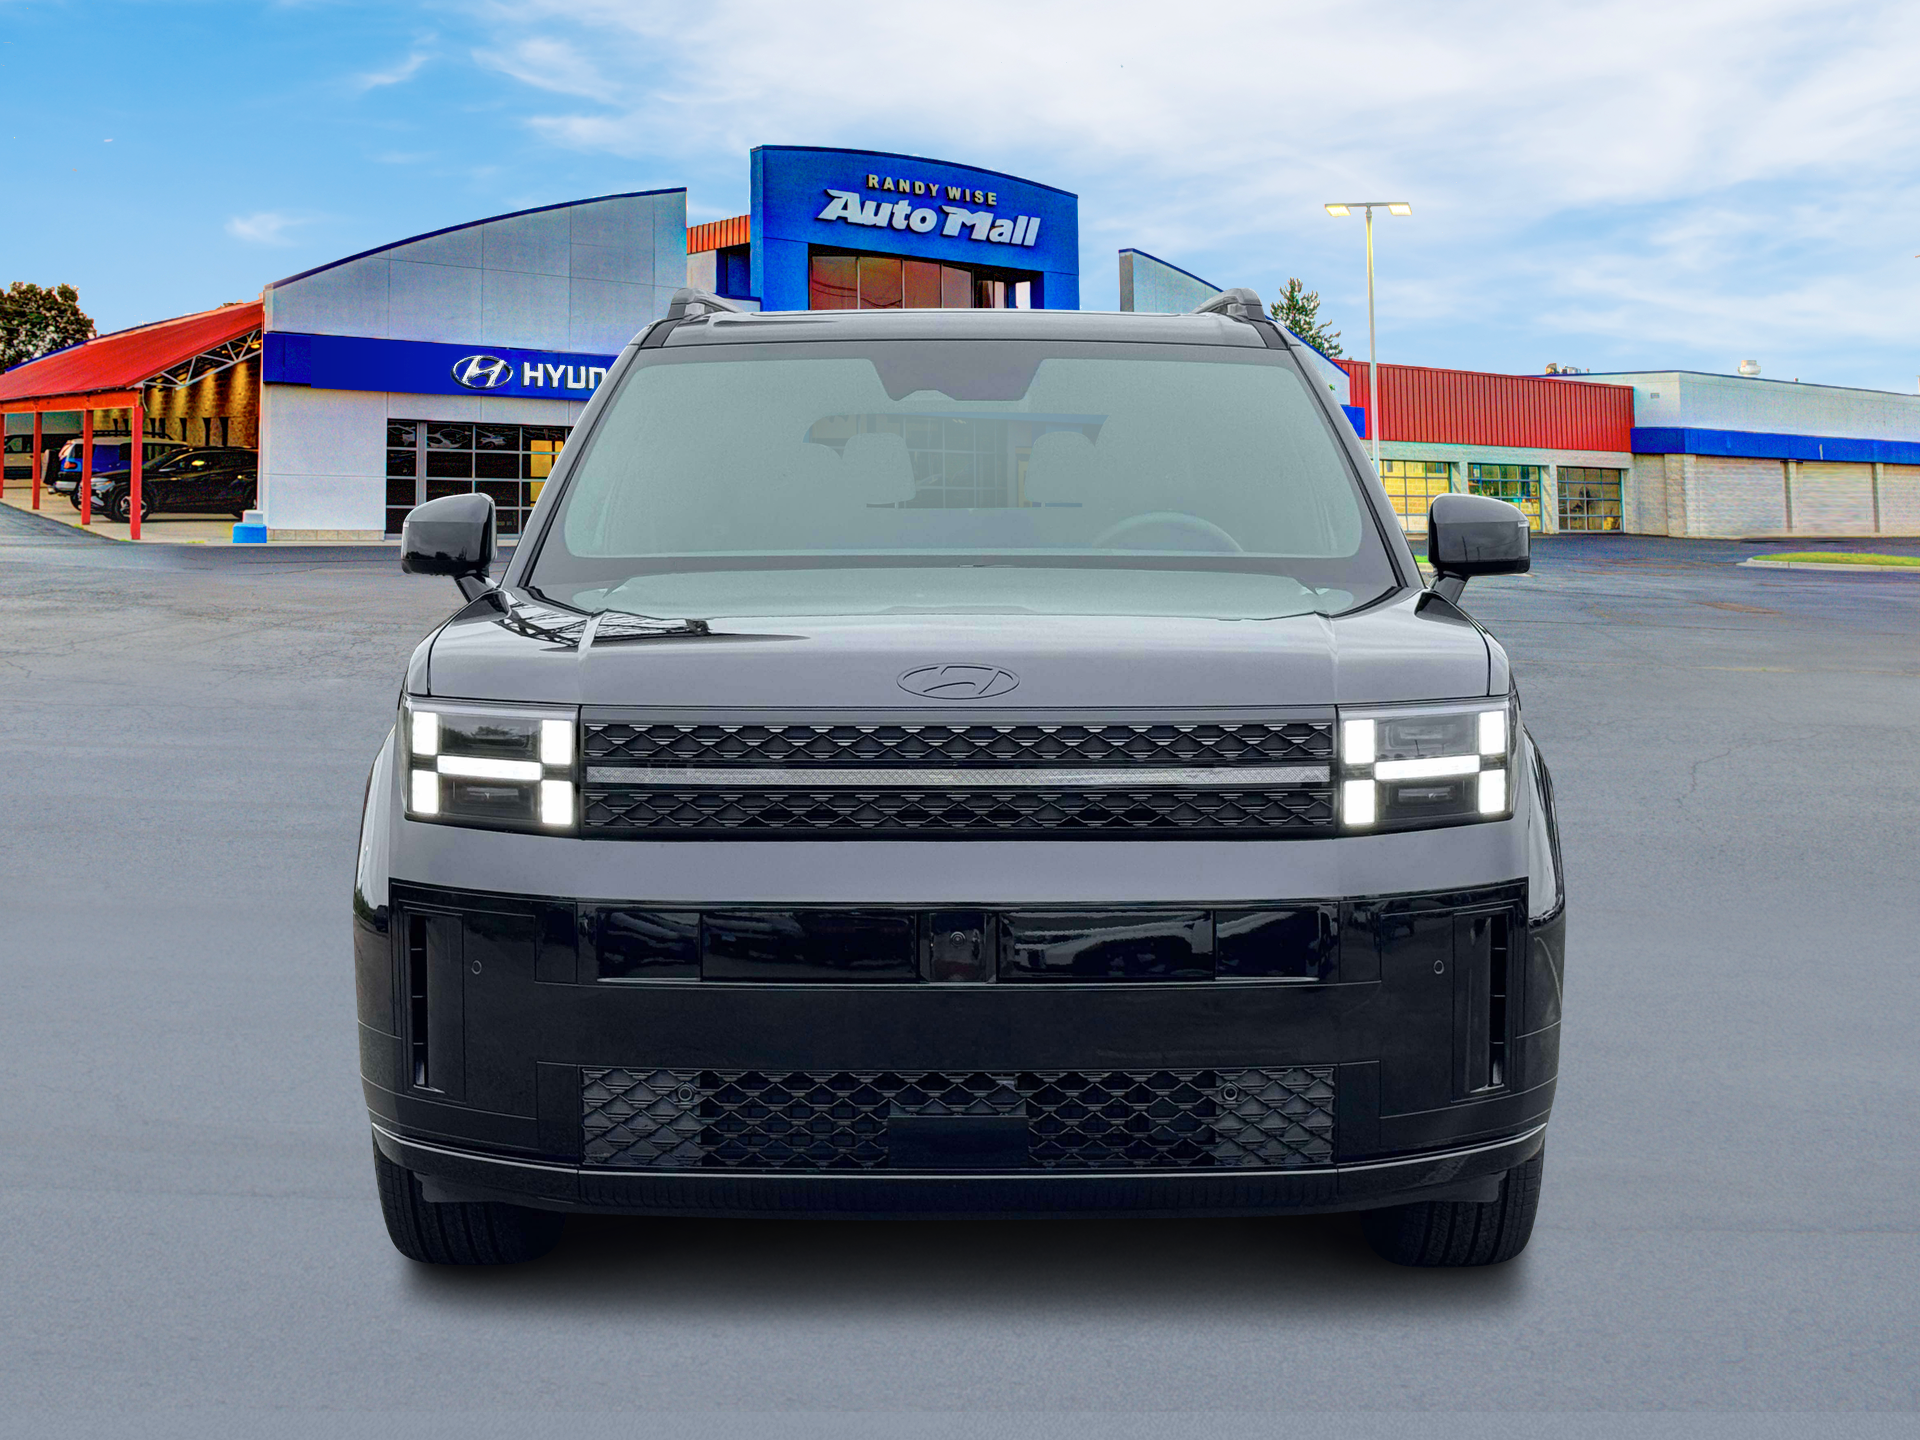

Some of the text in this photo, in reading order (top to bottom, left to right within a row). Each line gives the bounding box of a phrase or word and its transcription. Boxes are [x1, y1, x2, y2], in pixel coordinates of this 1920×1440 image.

[867, 174, 997, 206] RANDY WISE
[817, 189, 1041, 246] Auto Mall
